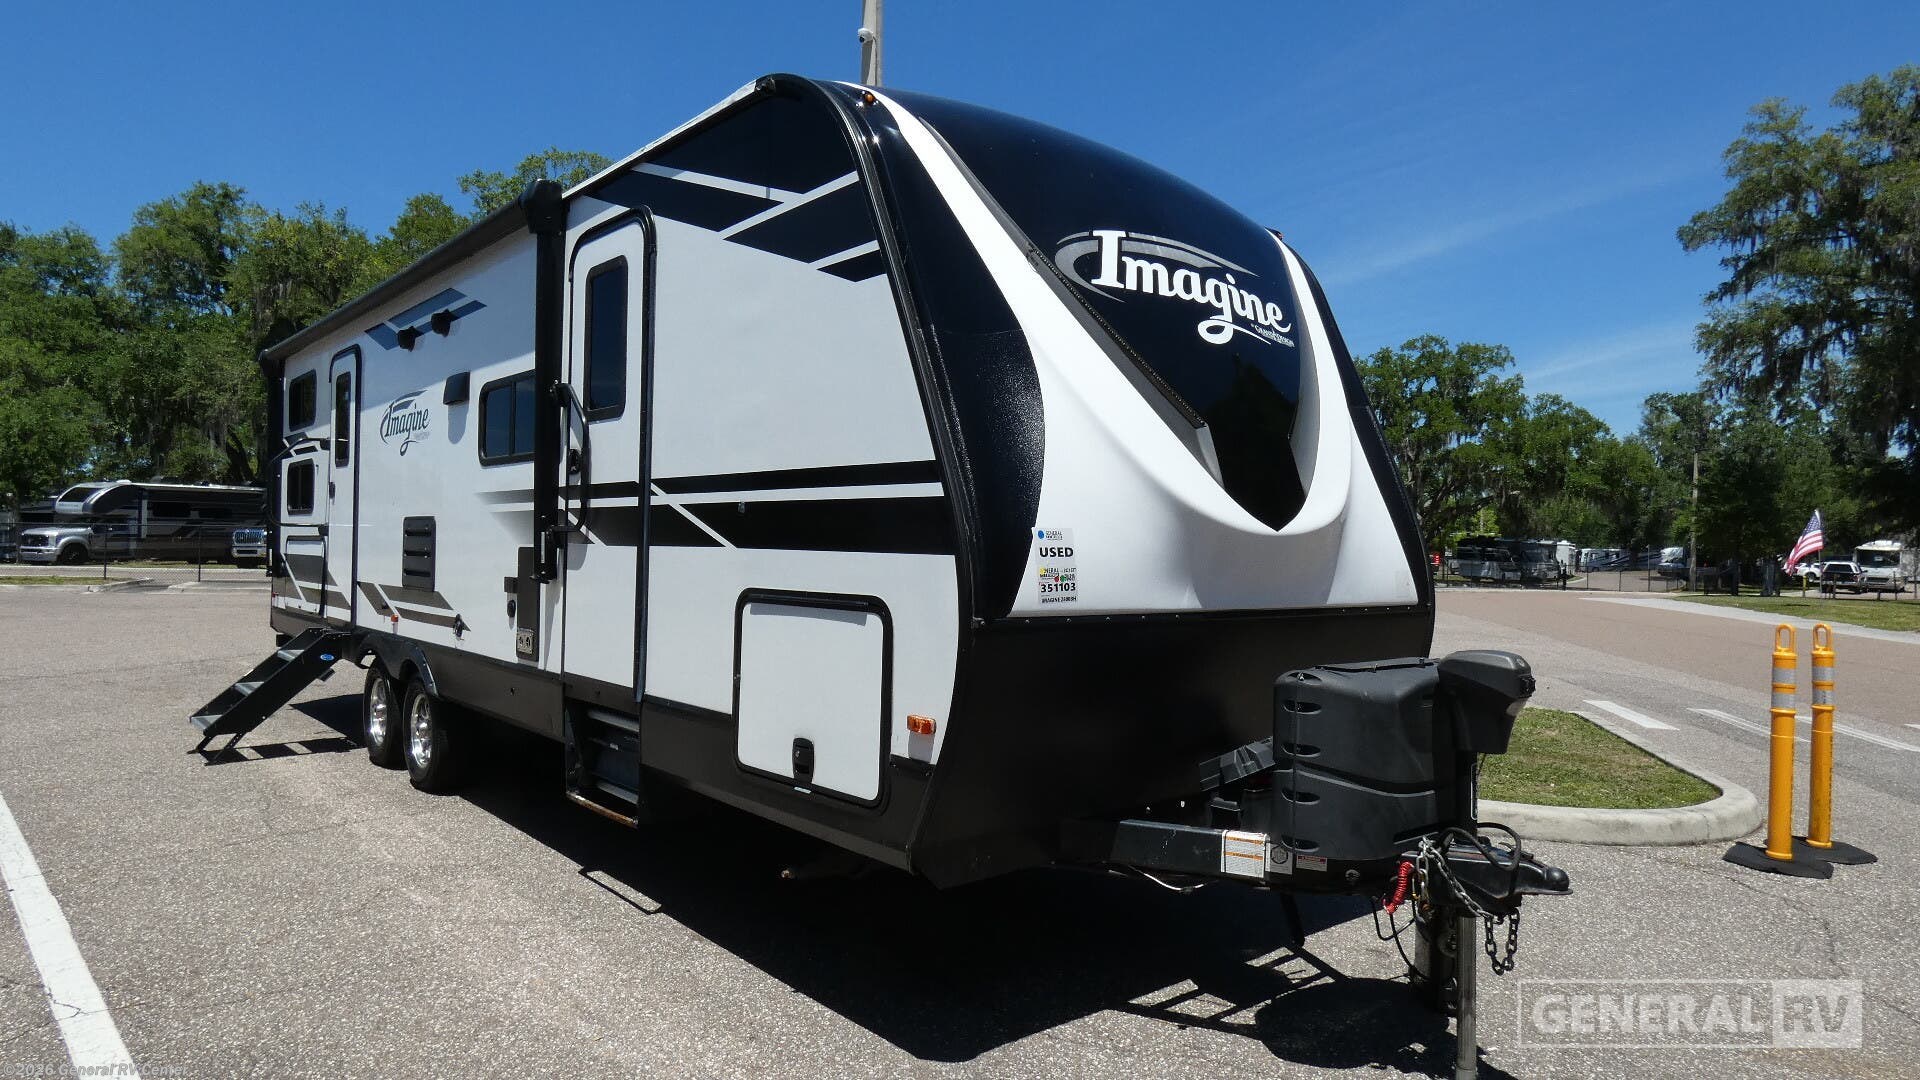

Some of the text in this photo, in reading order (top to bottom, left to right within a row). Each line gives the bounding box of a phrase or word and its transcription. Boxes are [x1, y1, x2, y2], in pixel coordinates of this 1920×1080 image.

[1091, 230, 1292, 345] Imagine
[384, 401, 430, 456] Imagine
[1039, 546, 1074, 558] USED
[1040, 582, 1076, 593] 351103
